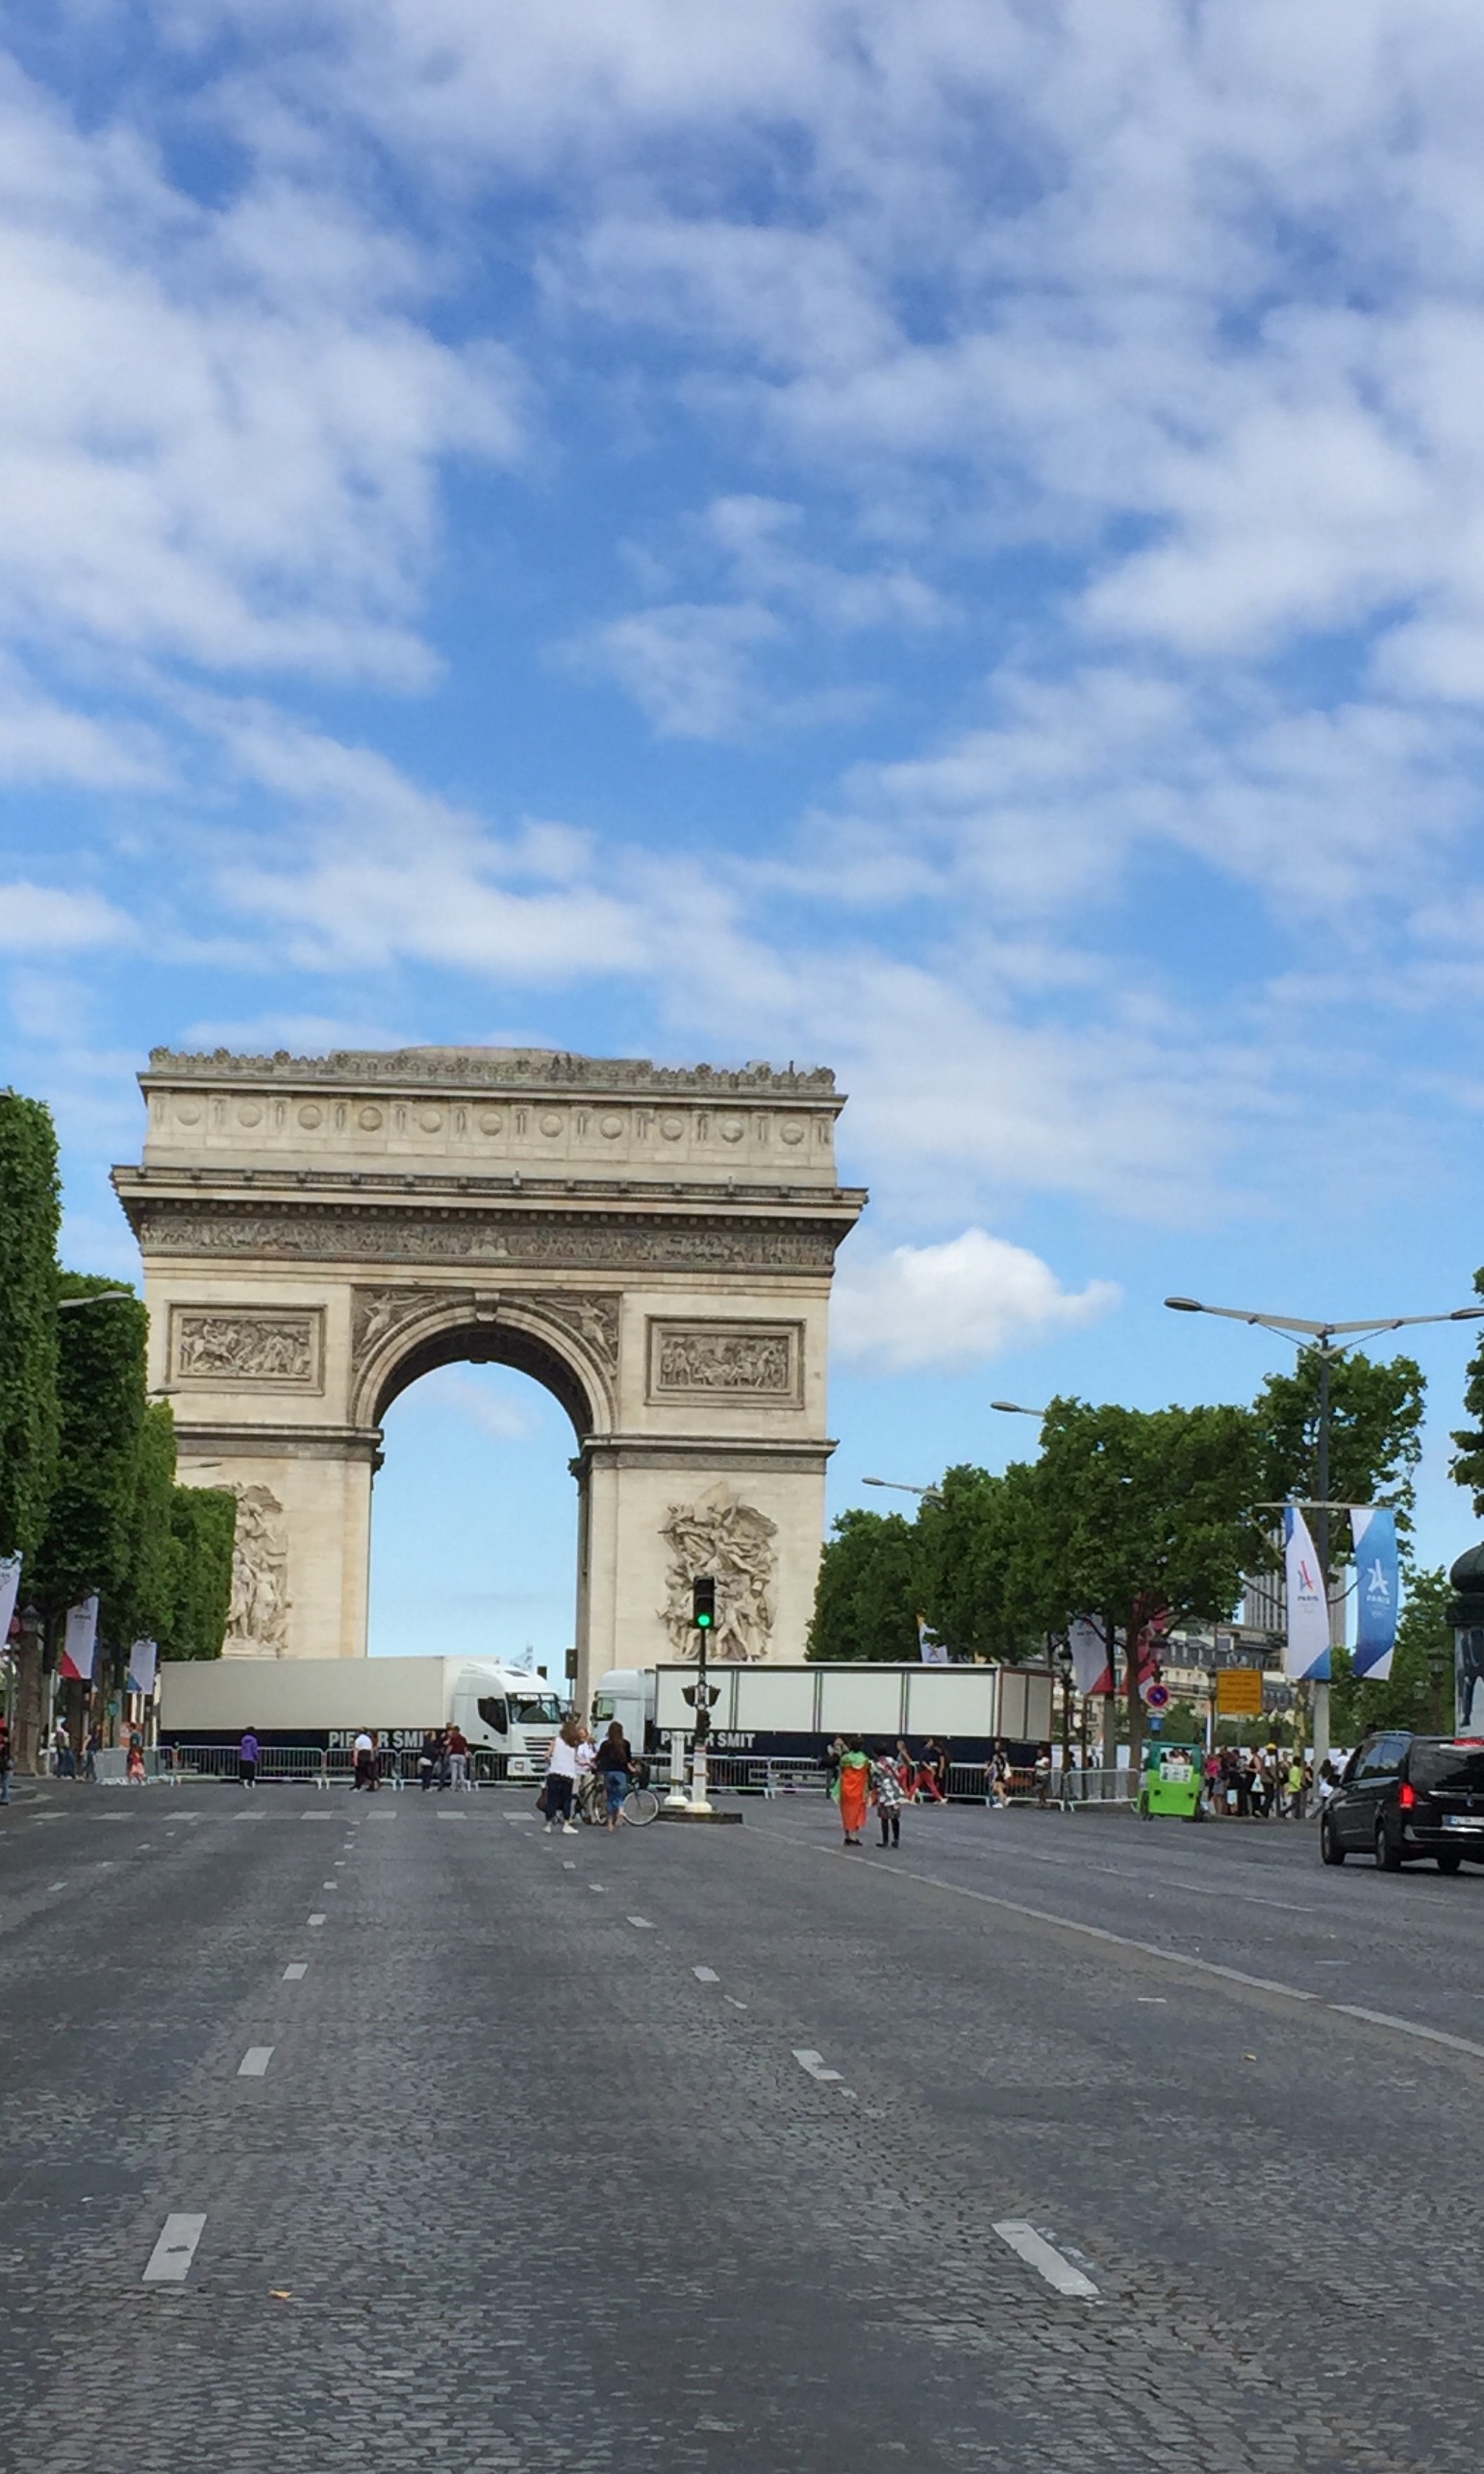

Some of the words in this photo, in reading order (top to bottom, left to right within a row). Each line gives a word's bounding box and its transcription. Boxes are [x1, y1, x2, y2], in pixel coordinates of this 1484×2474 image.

[329, 1731, 389, 1748] PIER
[392, 1730, 425, 1748] SMI
[717, 1732, 755, 1748] SMIT
